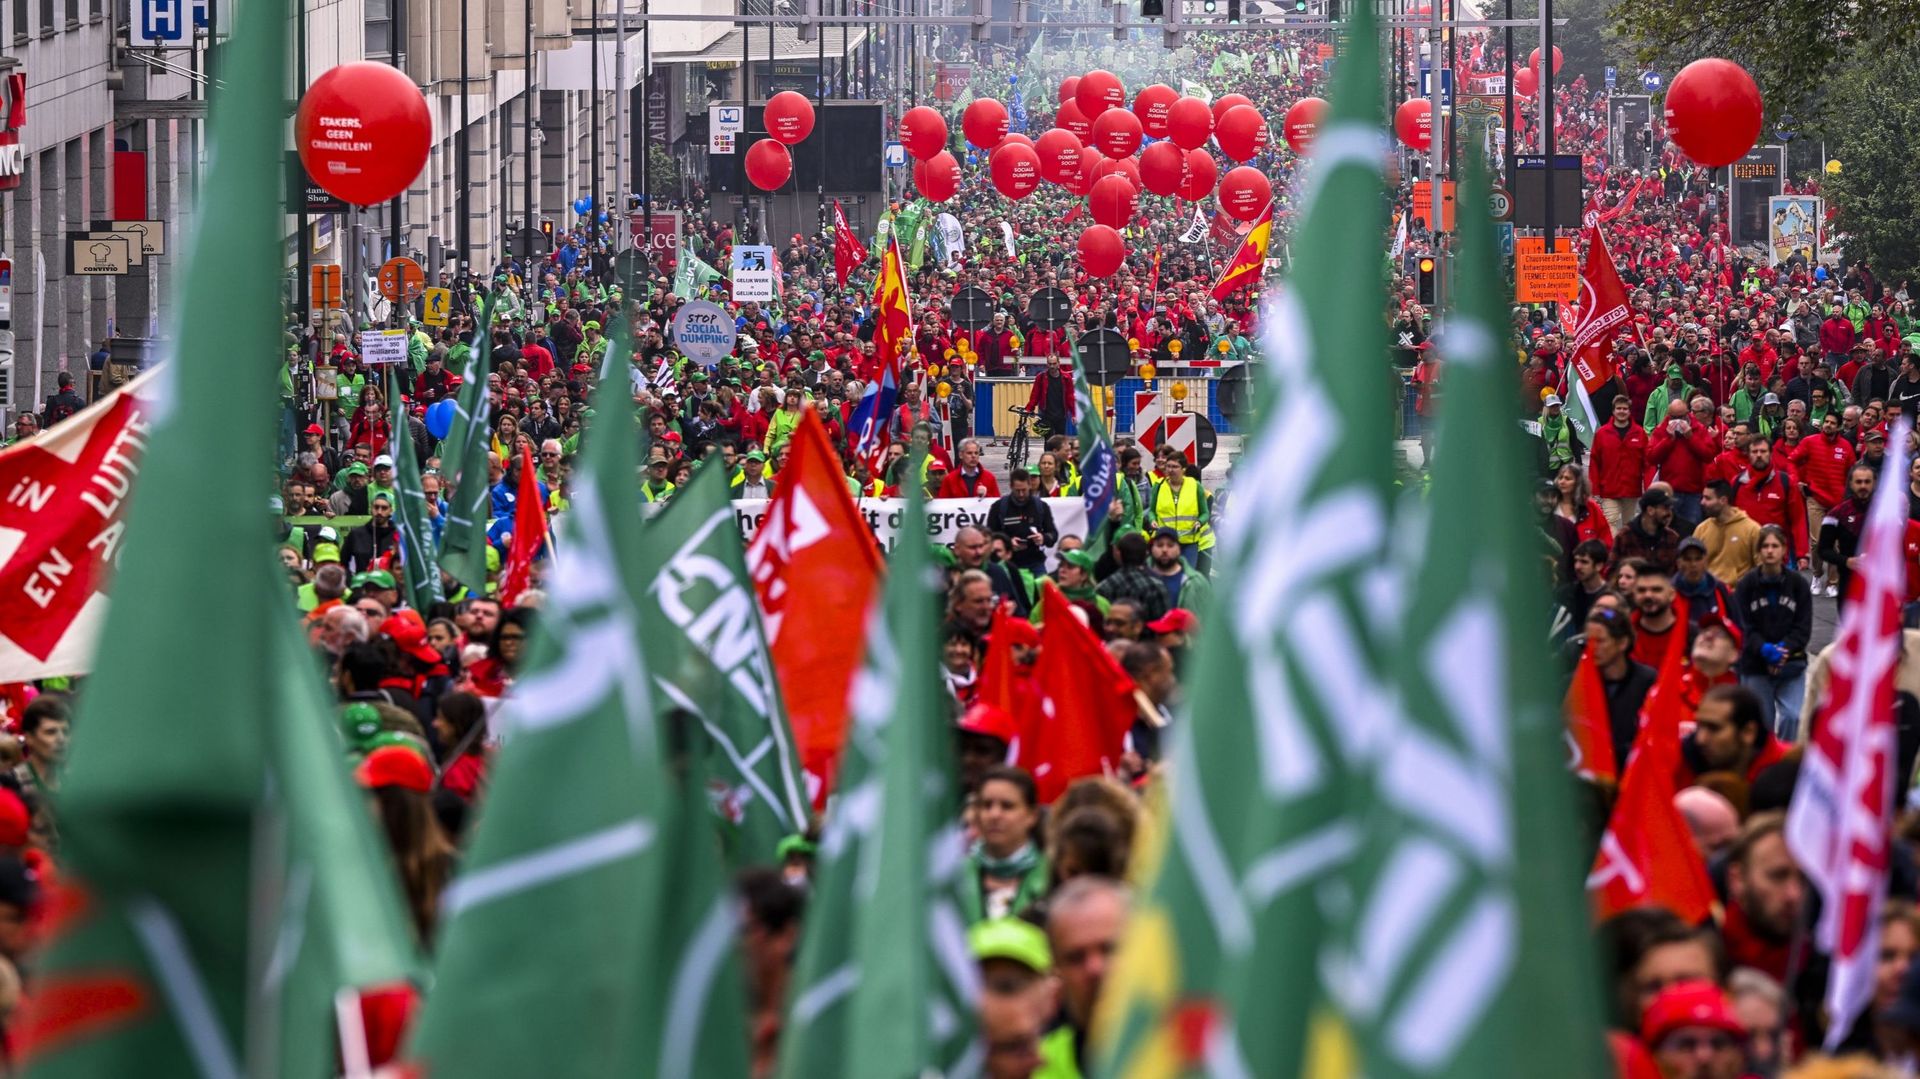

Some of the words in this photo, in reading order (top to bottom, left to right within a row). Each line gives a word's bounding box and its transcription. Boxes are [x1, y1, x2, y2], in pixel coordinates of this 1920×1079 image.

[149, 0, 175, 31] H
[775, 65, 802, 74] HOTEL
[320, 117, 362, 128] STAKERS,
[326, 130, 353, 139] GEEN
[312, 140, 372, 152] CRIMINELEN!
[308, 194, 329, 203] Shop
[1490, 198, 1506, 210] 50
[688, 313, 718, 324] STOP
[686, 324, 722, 334] SOCIAL
[680, 334, 730, 344] DUMPING
[927, 508, 987, 535] grèv
[22, 546, 74, 609] EN
